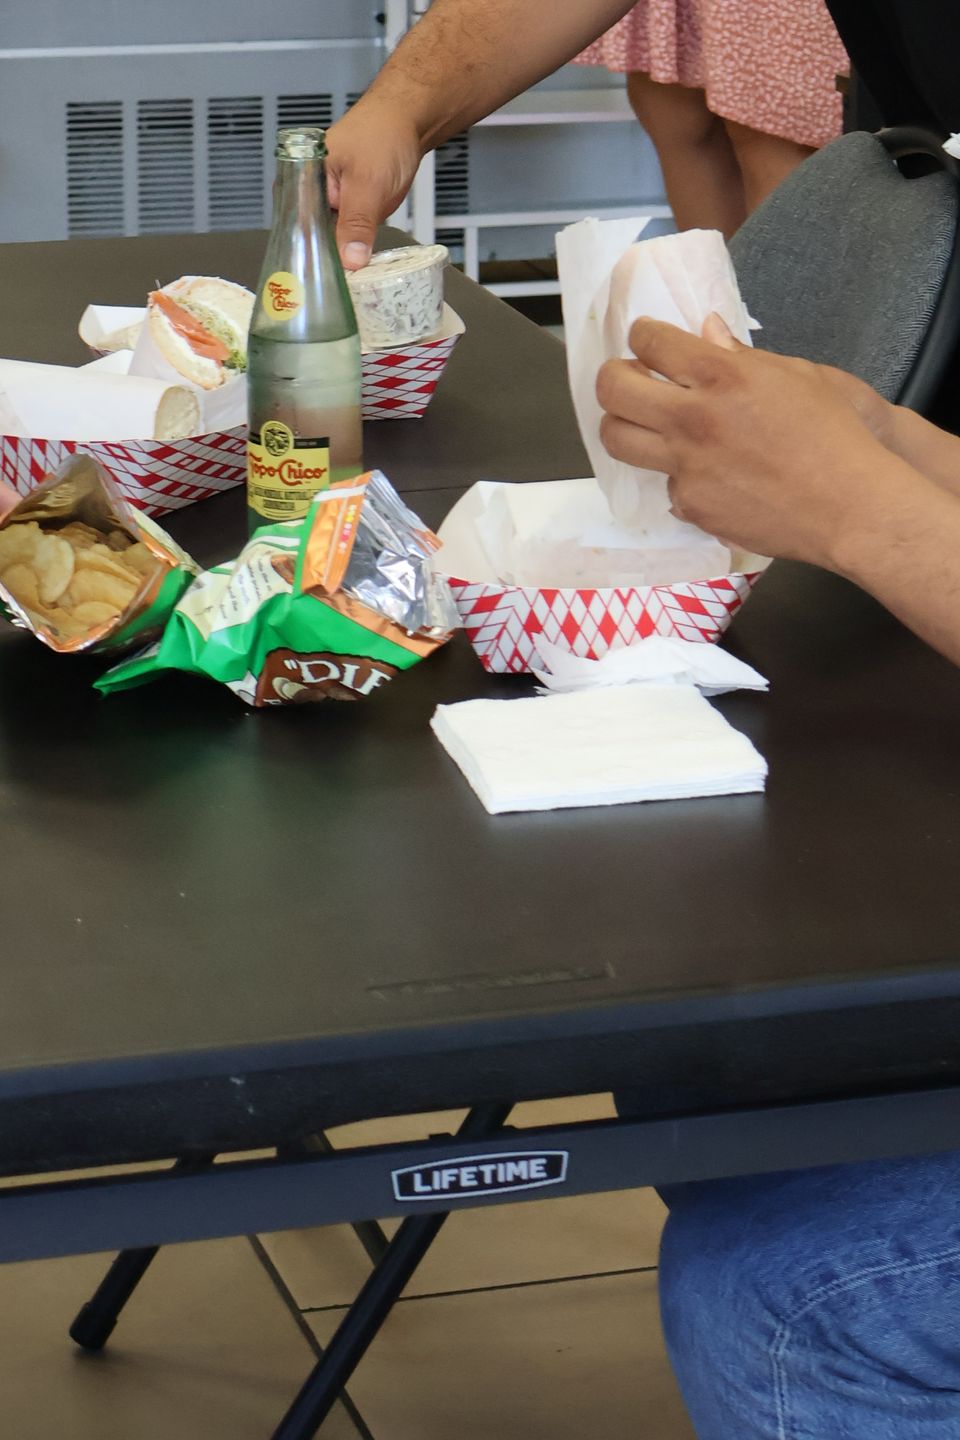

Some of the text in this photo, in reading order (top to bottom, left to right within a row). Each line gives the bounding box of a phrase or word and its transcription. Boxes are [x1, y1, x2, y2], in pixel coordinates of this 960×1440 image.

[268, 281, 292, 298] Topo
[272, 295, 299, 312] Chico
[248, 451, 327, 487] Topo Chico
[413, 1157, 548, 1193] LIFETIME
